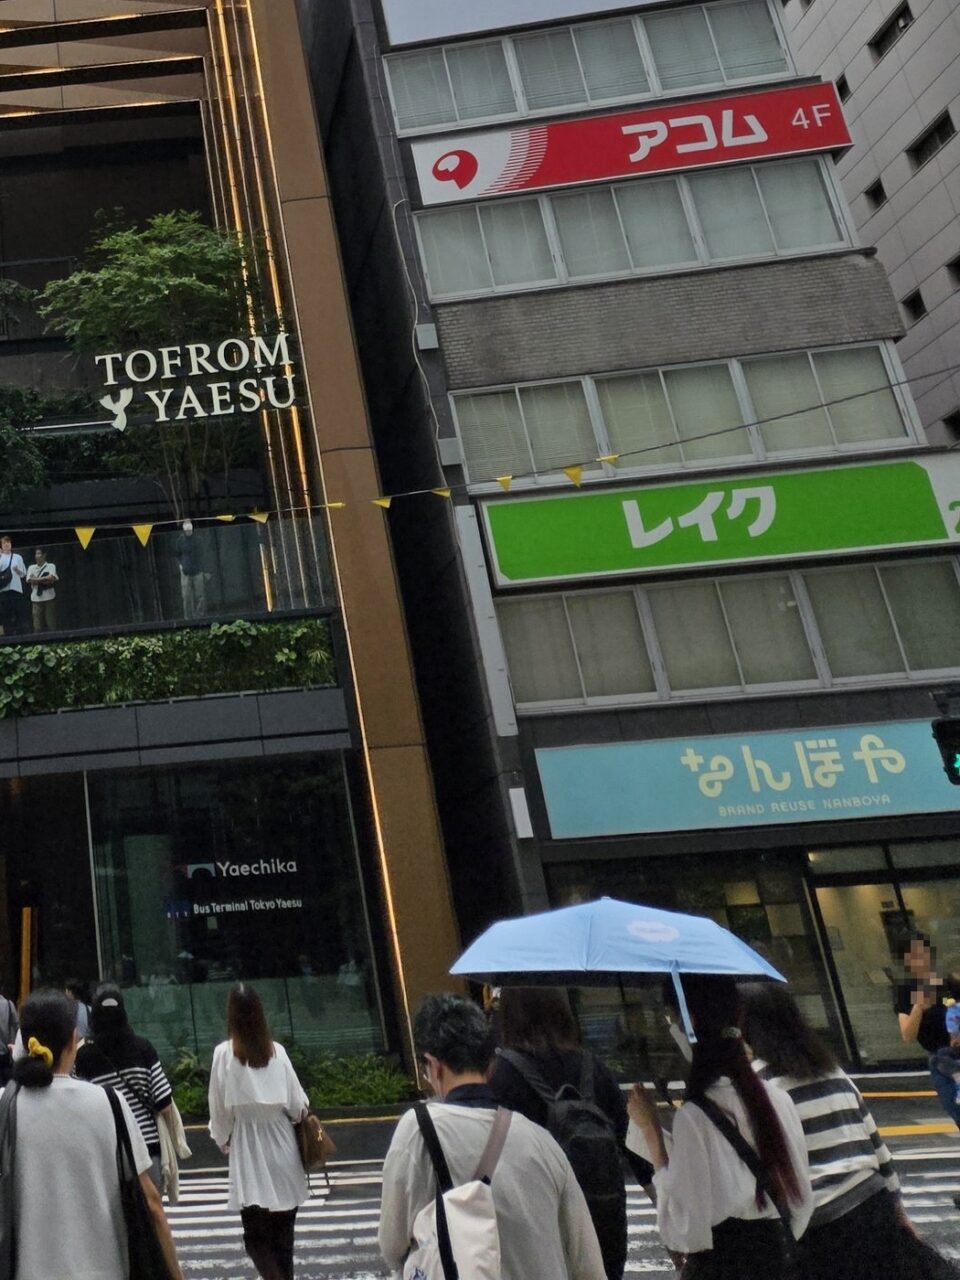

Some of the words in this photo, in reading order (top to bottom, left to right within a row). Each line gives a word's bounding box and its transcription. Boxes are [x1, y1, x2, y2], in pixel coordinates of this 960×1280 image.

[621, 109, 768, 163] アコム
[791, 104, 832, 130] 4F
[94, 333, 295, 386] TOFROM
[145, 374, 297, 422] YAESU
[622, 485, 777, 549] レイク
[680, 733, 906, 798] なんぼや
[719, 803, 766, 818] BRAND
[771, 799, 817, 814] REUSE
[823, 794, 892, 811] NANBOYA
[216, 858, 298, 877] Yaechika
[193, 903, 211, 914] Bus
[211, 900, 248, 913] Terminal
[250, 898, 276, 911] Tokyo
[276, 897, 303, 909] Yaesu
